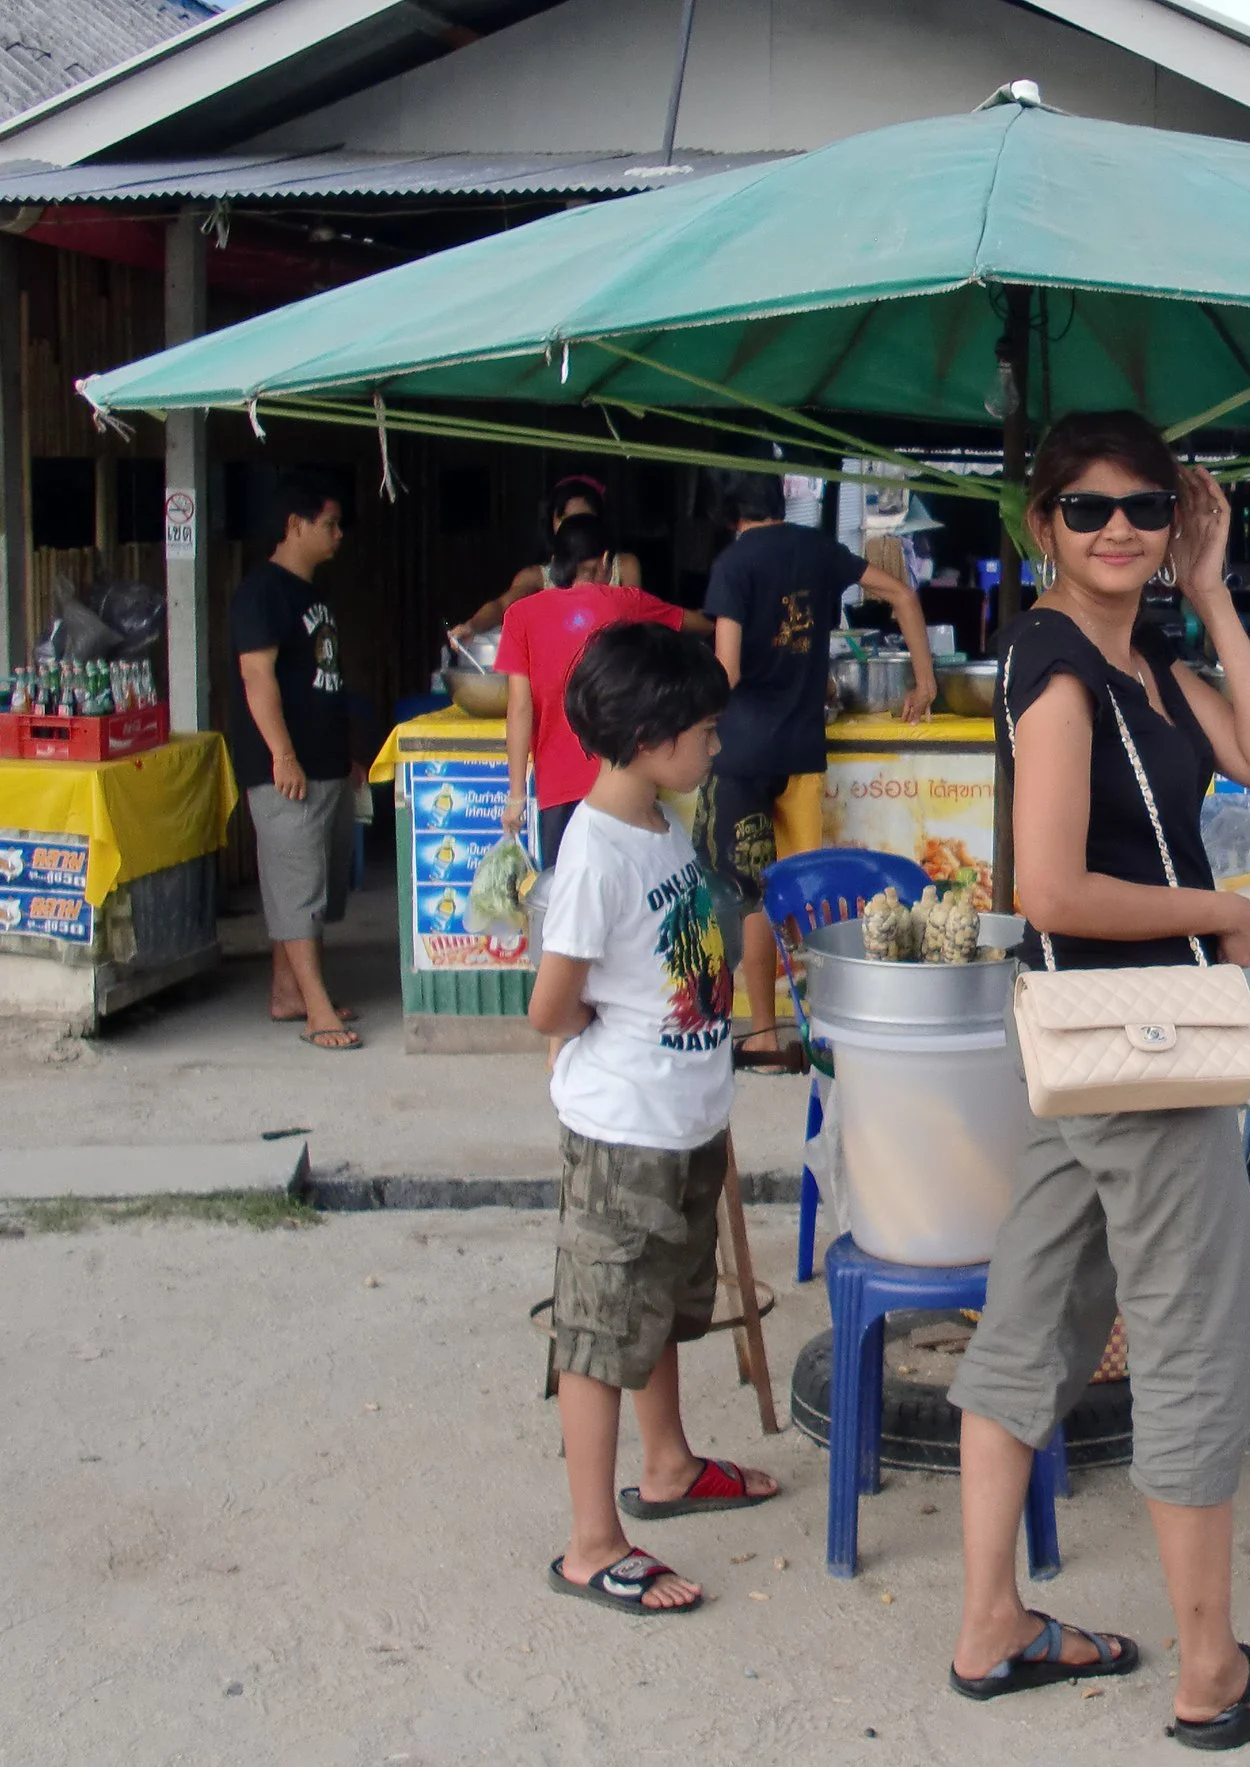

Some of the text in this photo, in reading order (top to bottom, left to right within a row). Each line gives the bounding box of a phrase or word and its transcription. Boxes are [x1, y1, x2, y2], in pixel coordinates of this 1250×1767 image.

[851, 772, 918, 799] อร่อย
[928, 778, 994, 802] ได้สุขภา
[647, 873, 681, 912] ONE
